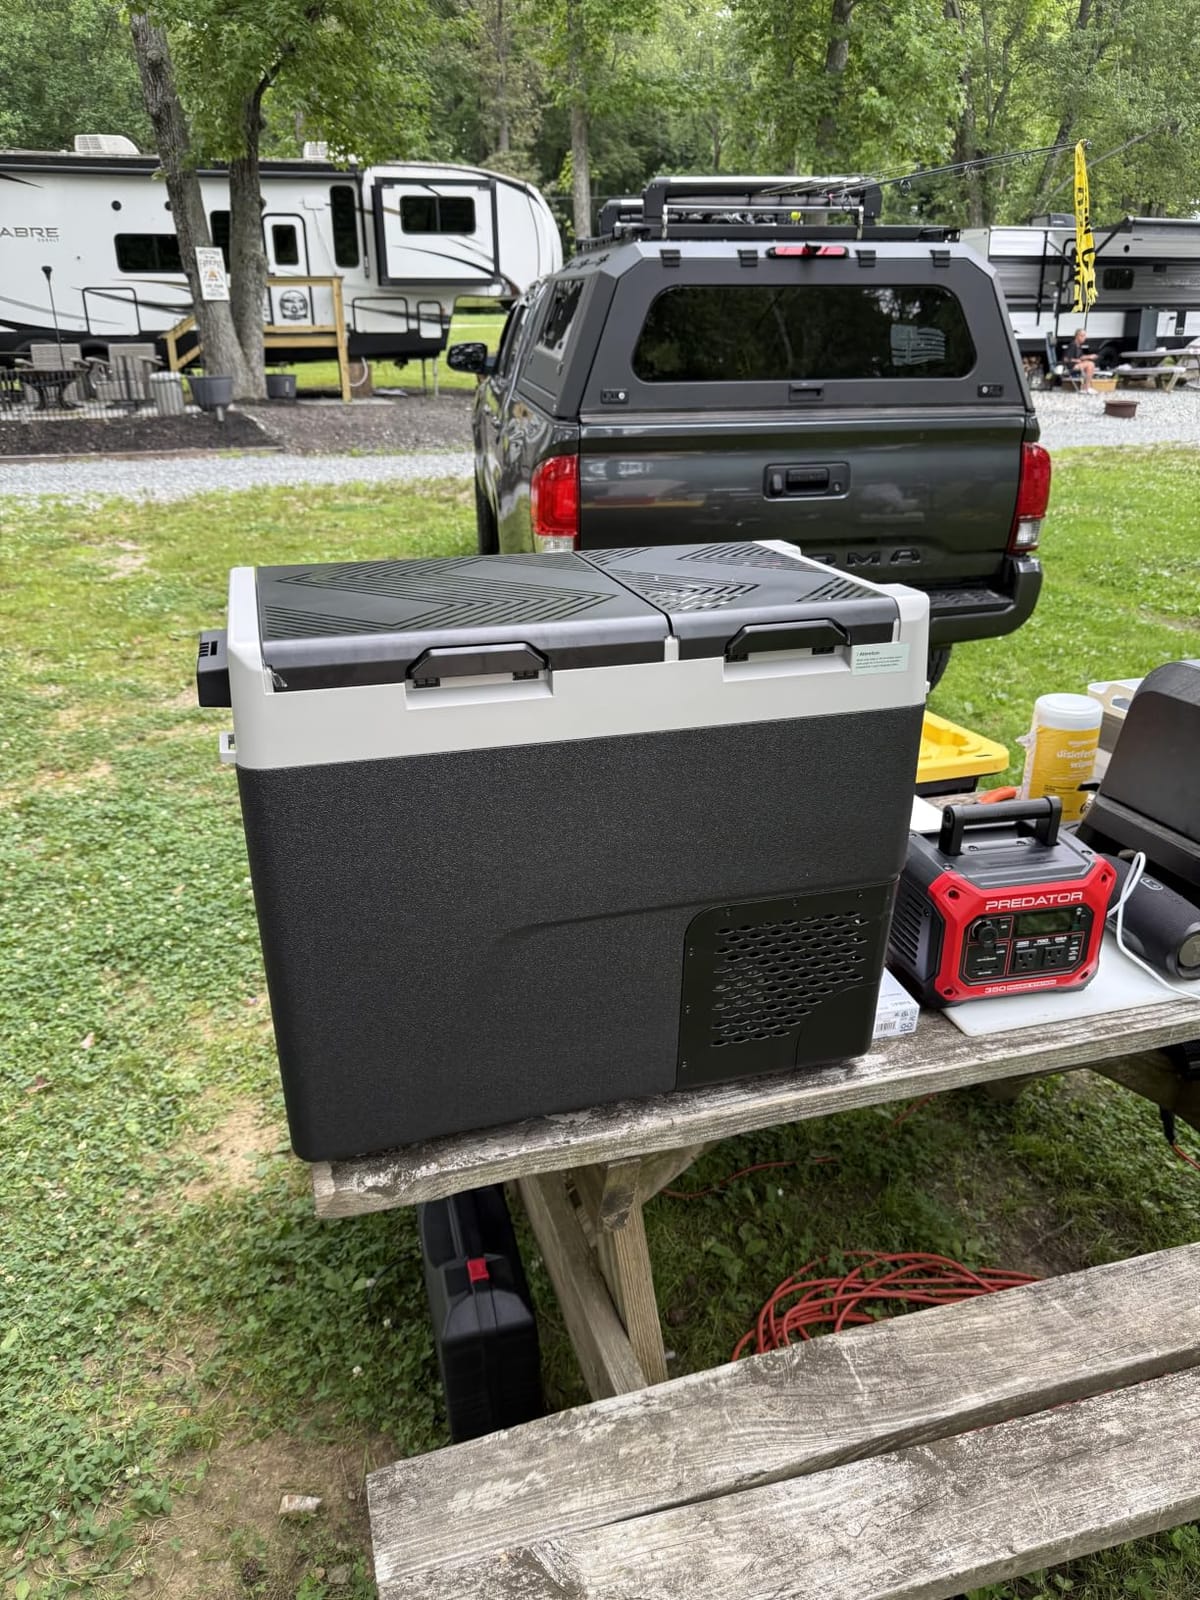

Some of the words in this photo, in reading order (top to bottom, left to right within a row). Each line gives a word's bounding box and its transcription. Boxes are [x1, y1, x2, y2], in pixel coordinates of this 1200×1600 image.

[0, 227, 60, 238] ABRE
[985, 892, 1083, 911] PREDATOR
[984, 986, 1006, 994] 350
